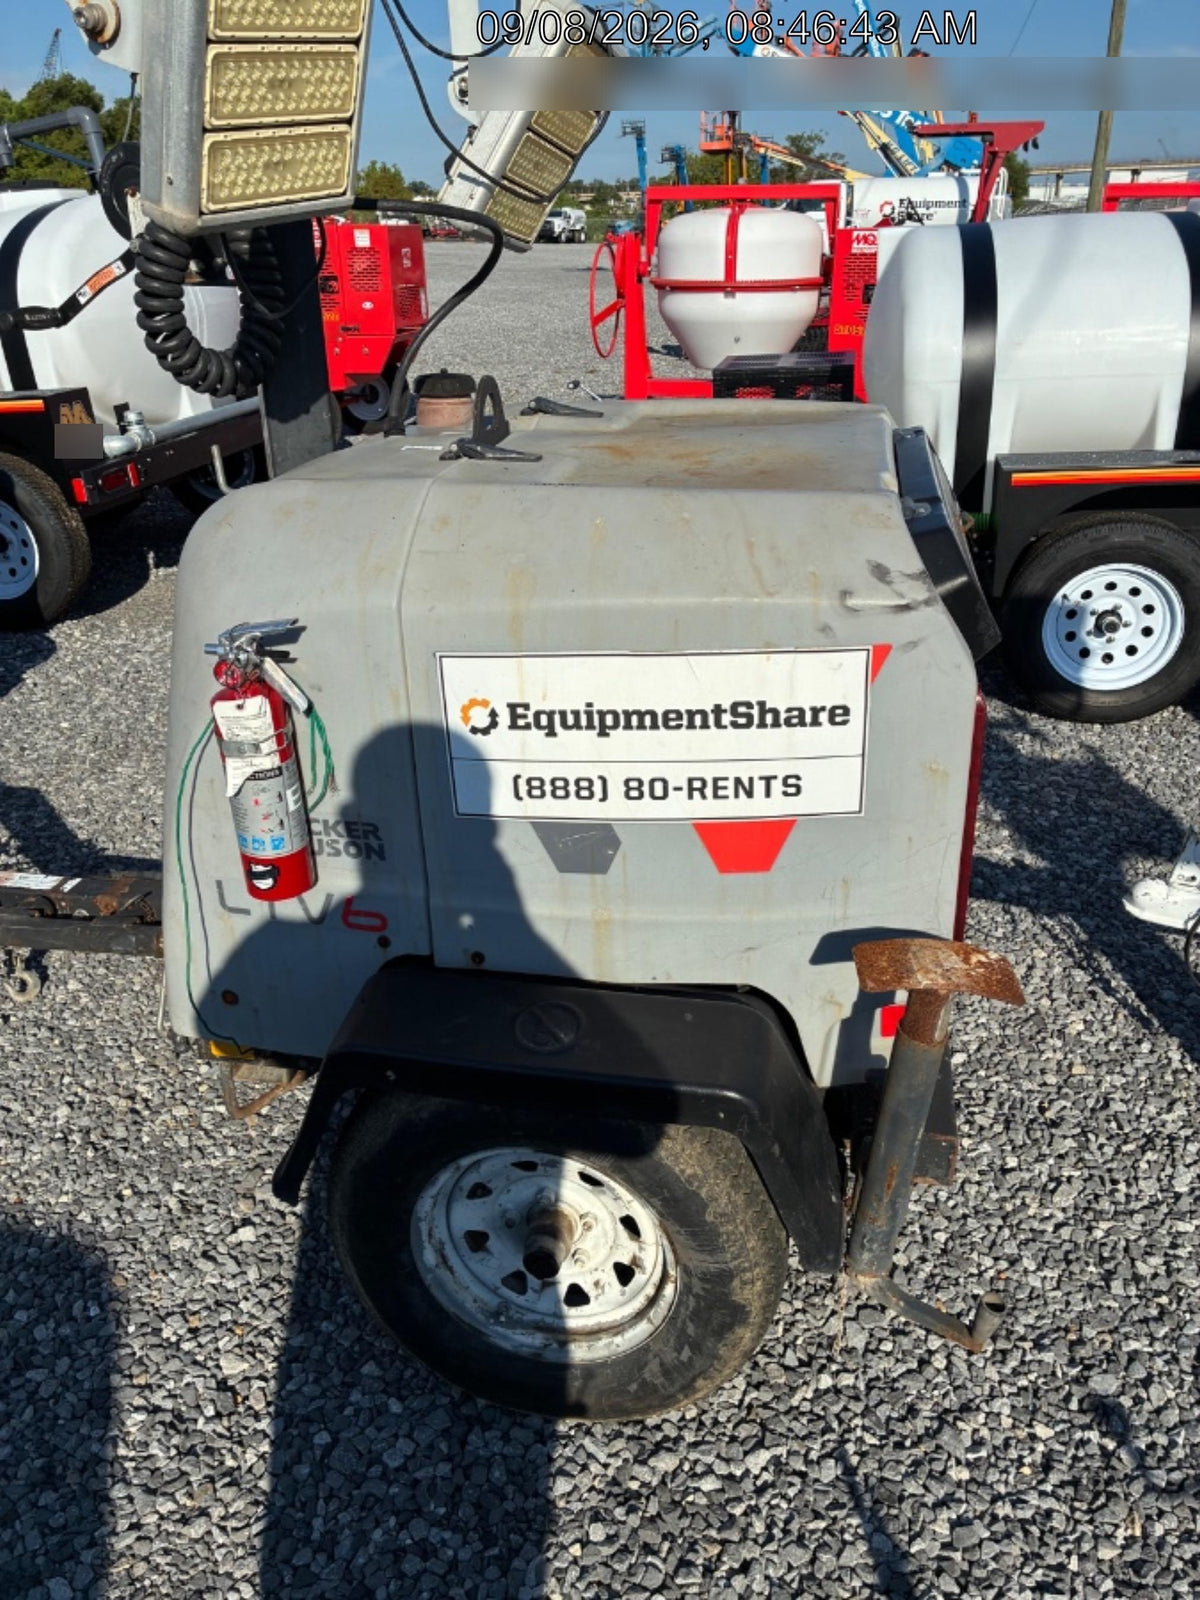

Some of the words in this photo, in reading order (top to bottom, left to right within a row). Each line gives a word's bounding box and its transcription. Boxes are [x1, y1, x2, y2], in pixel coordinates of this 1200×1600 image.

[507, 700, 851, 737] EquipmentShare
[513, 774, 609, 801] (888)
[624, 773, 803, 801] 80-RENTS
